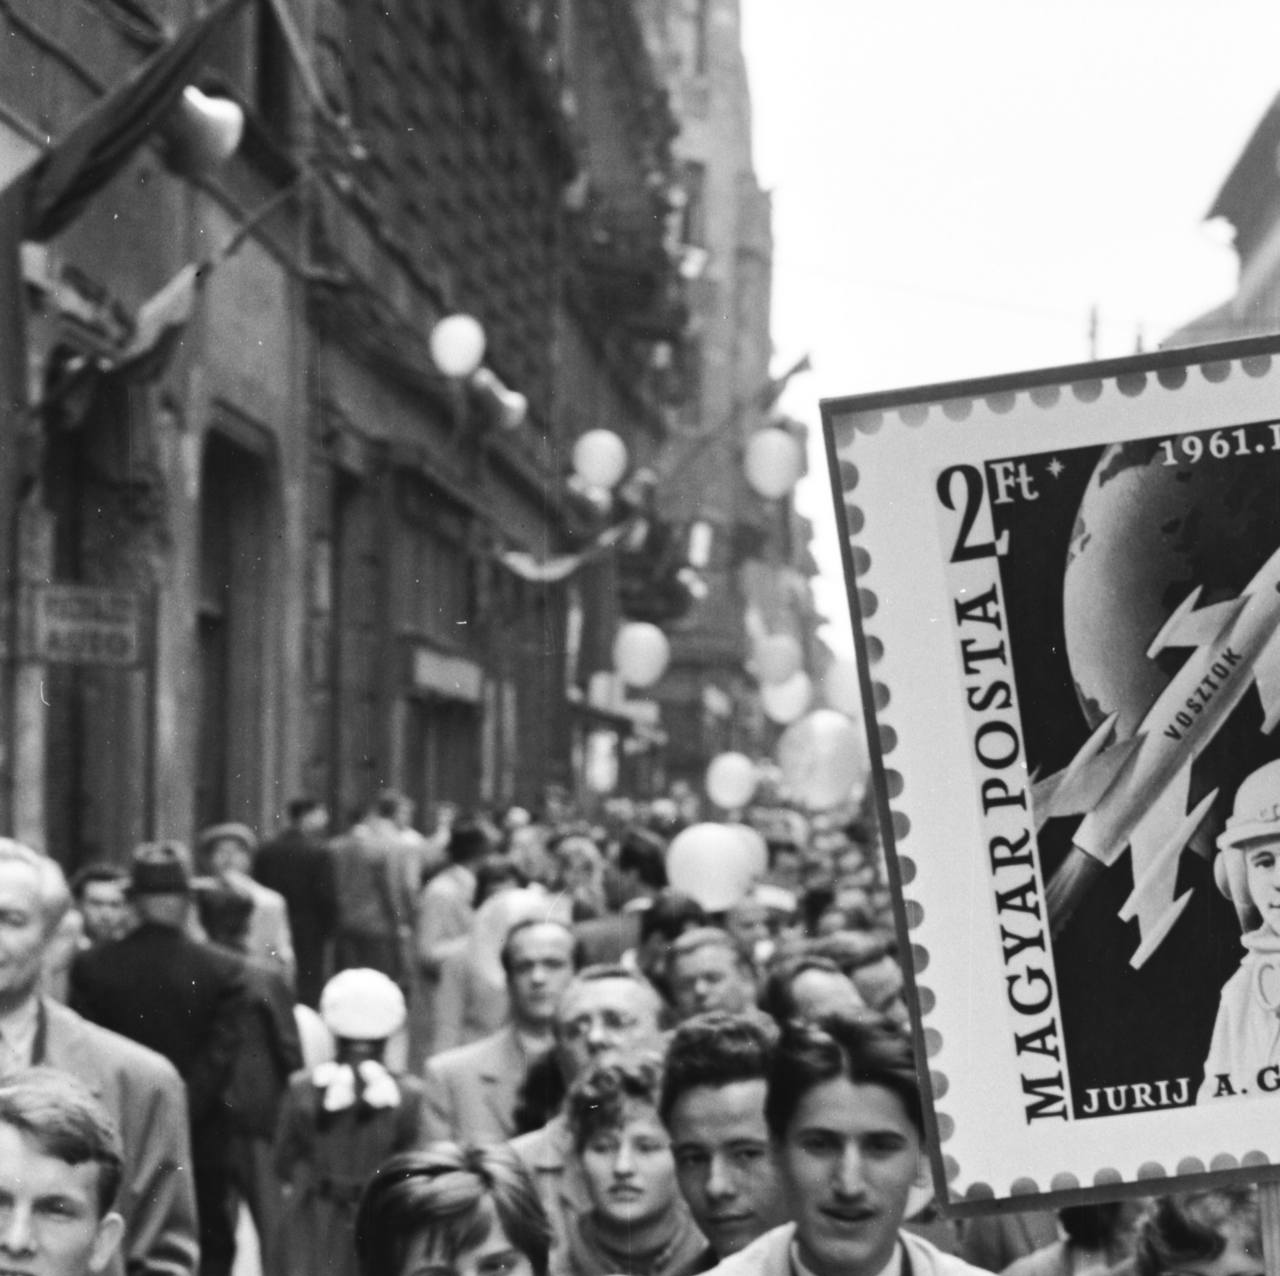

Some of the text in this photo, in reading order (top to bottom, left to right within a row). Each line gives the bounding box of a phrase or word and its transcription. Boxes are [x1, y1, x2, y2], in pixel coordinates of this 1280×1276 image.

[935, 460, 1040, 564] 2 Ft
[1163, 647, 1242, 740] VOSZTOK
[953, 582, 1069, 1126] MAGYAR POSTA
[1082, 1077, 1192, 1115] JURIJ
[1212, 1073, 1248, 1098] A.
